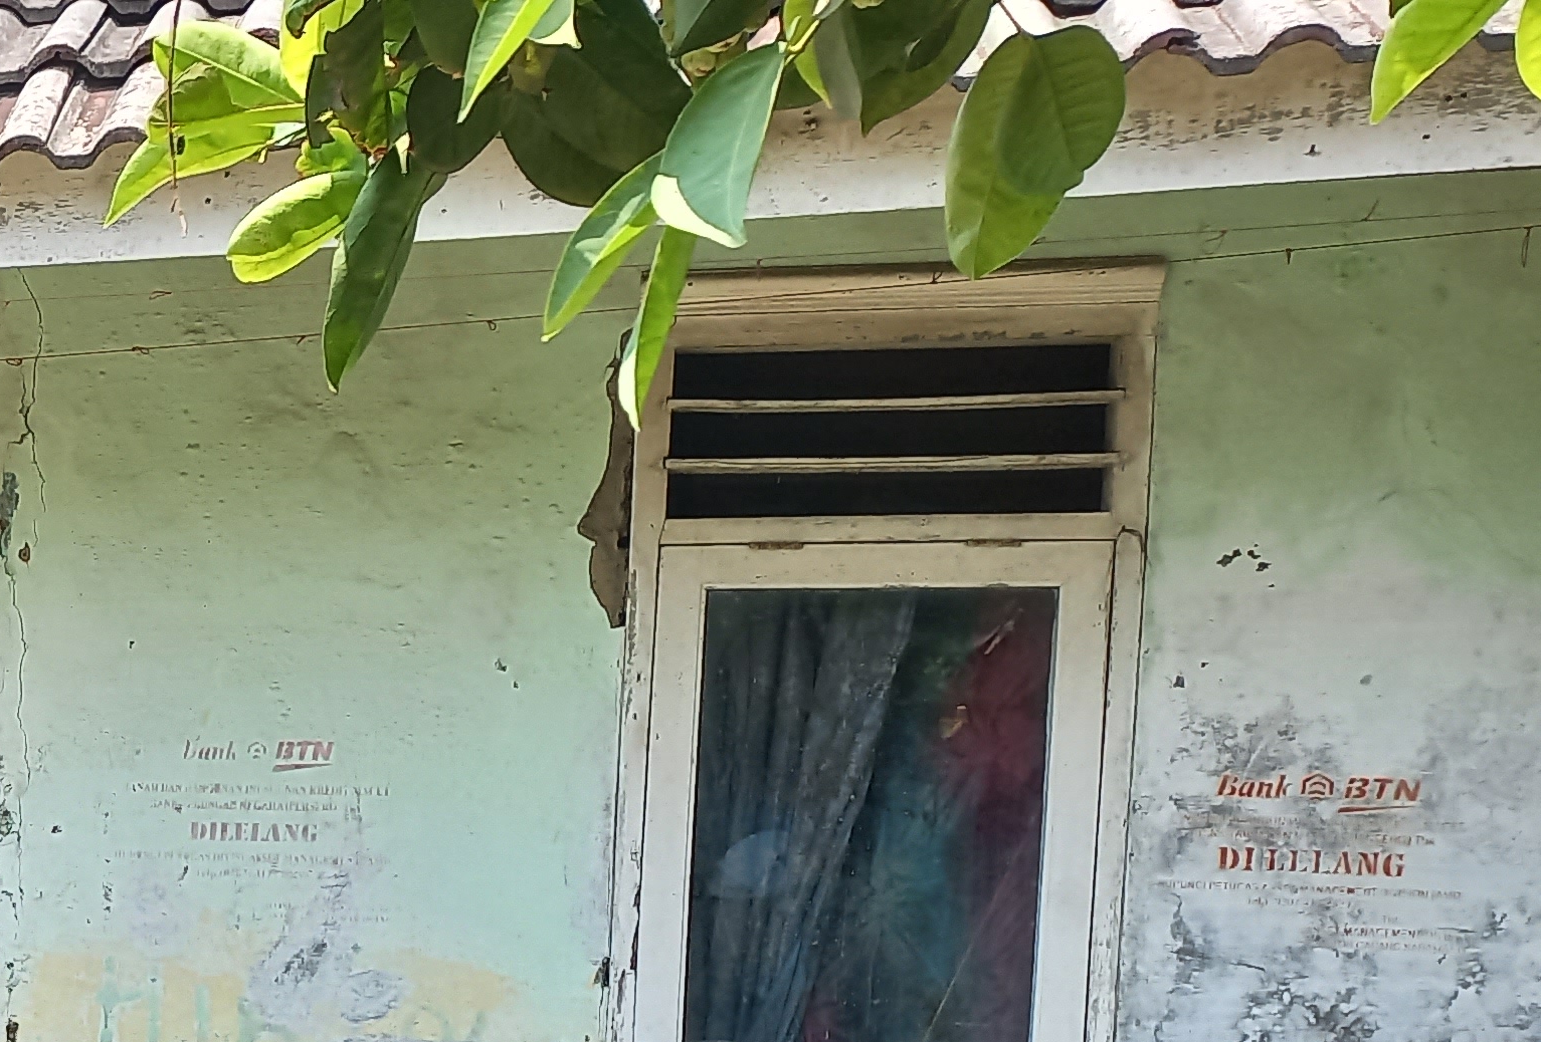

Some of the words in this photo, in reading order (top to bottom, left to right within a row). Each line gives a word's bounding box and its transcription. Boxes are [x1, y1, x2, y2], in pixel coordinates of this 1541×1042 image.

[275, 741, 334, 761] BTN
[1217, 774, 1292, 799] Bank
[1344, 777, 1421, 801] BTN
[191, 822, 317, 842] DILELANG
